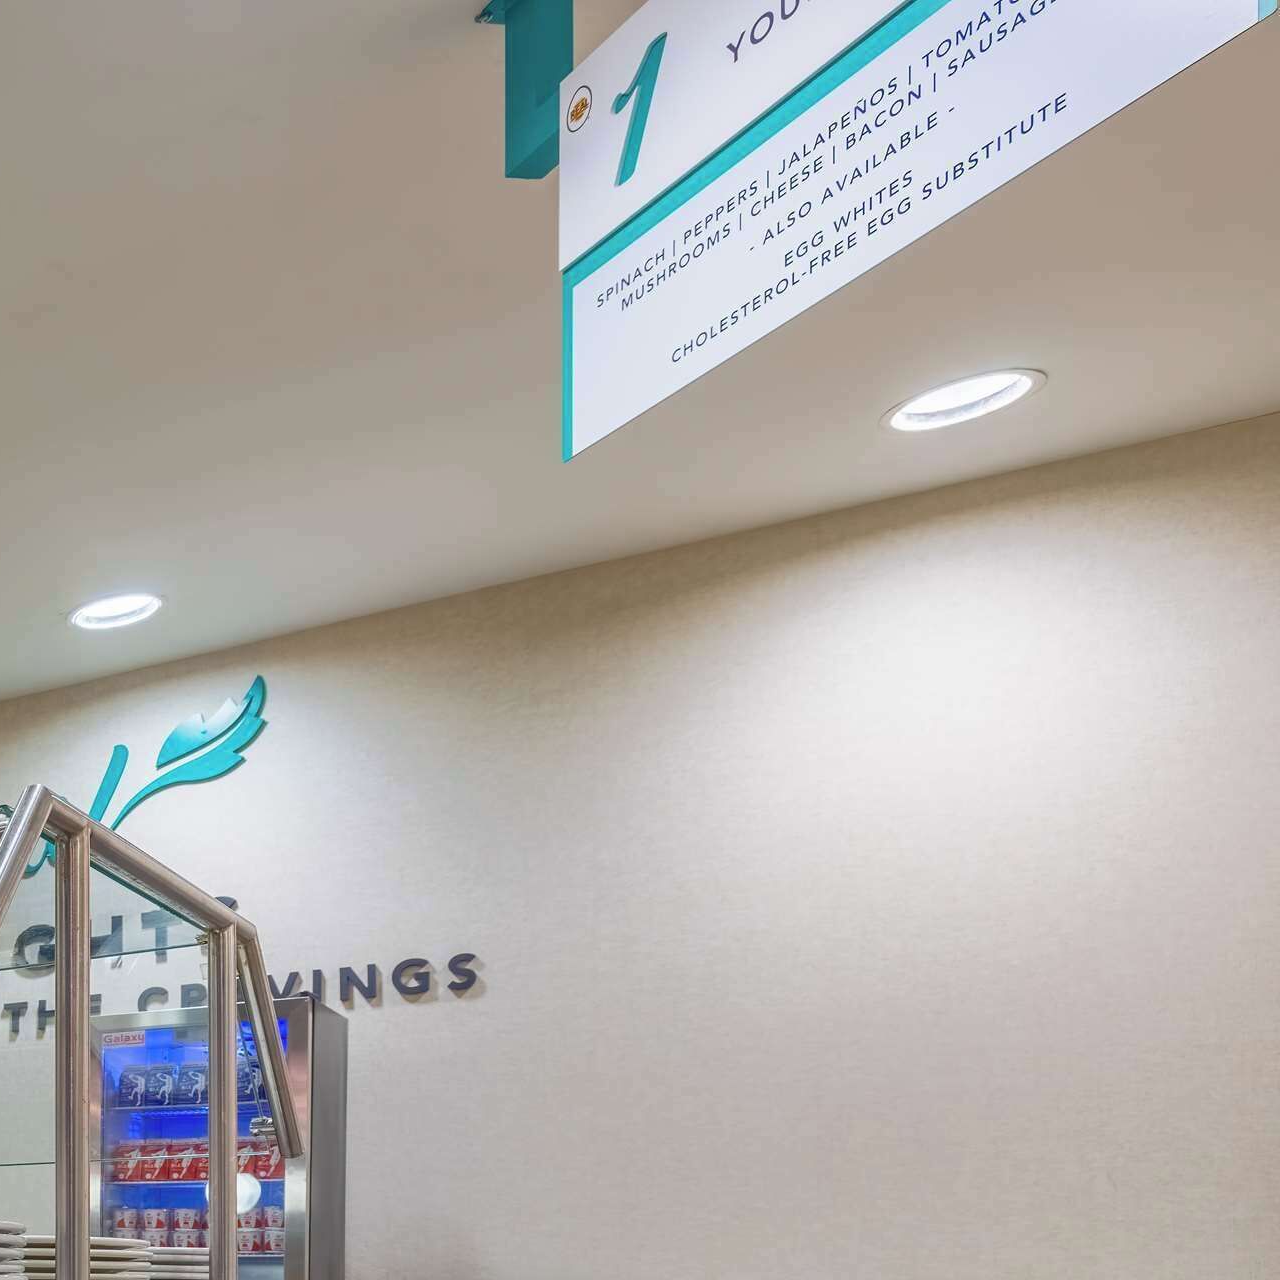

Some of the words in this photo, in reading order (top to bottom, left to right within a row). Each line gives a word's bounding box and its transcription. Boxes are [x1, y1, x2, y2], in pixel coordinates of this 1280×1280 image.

[612, 31, 667, 187] 1
[725, 0, 809, 63] YOU
[597, 248, 665, 308] SPINACH
[683, 180, 758, 245] PEPPERS
[778, 76, 898, 176] JALAPEÑOS
[921, 0, 1018, 68] TOMAT
[621, 222, 731, 312] MUSHROOMS
[750, 155, 823, 217] CHEESE
[845, 84, 922, 150] BACON
[947, 0, 1057, 77] SAUSAG
[671, 231, 858, 363] CHOLESTEROL-FREE
[867, 196, 912, 236] EGG
[921, 92, 1068, 201] SUBSTITUTE
[762, 201, 812, 246] ALSO
[821, 111, 938, 205] AVAILABLE
[784, 230, 824, 267] EGG
[833, 169, 913, 233] WHITES
